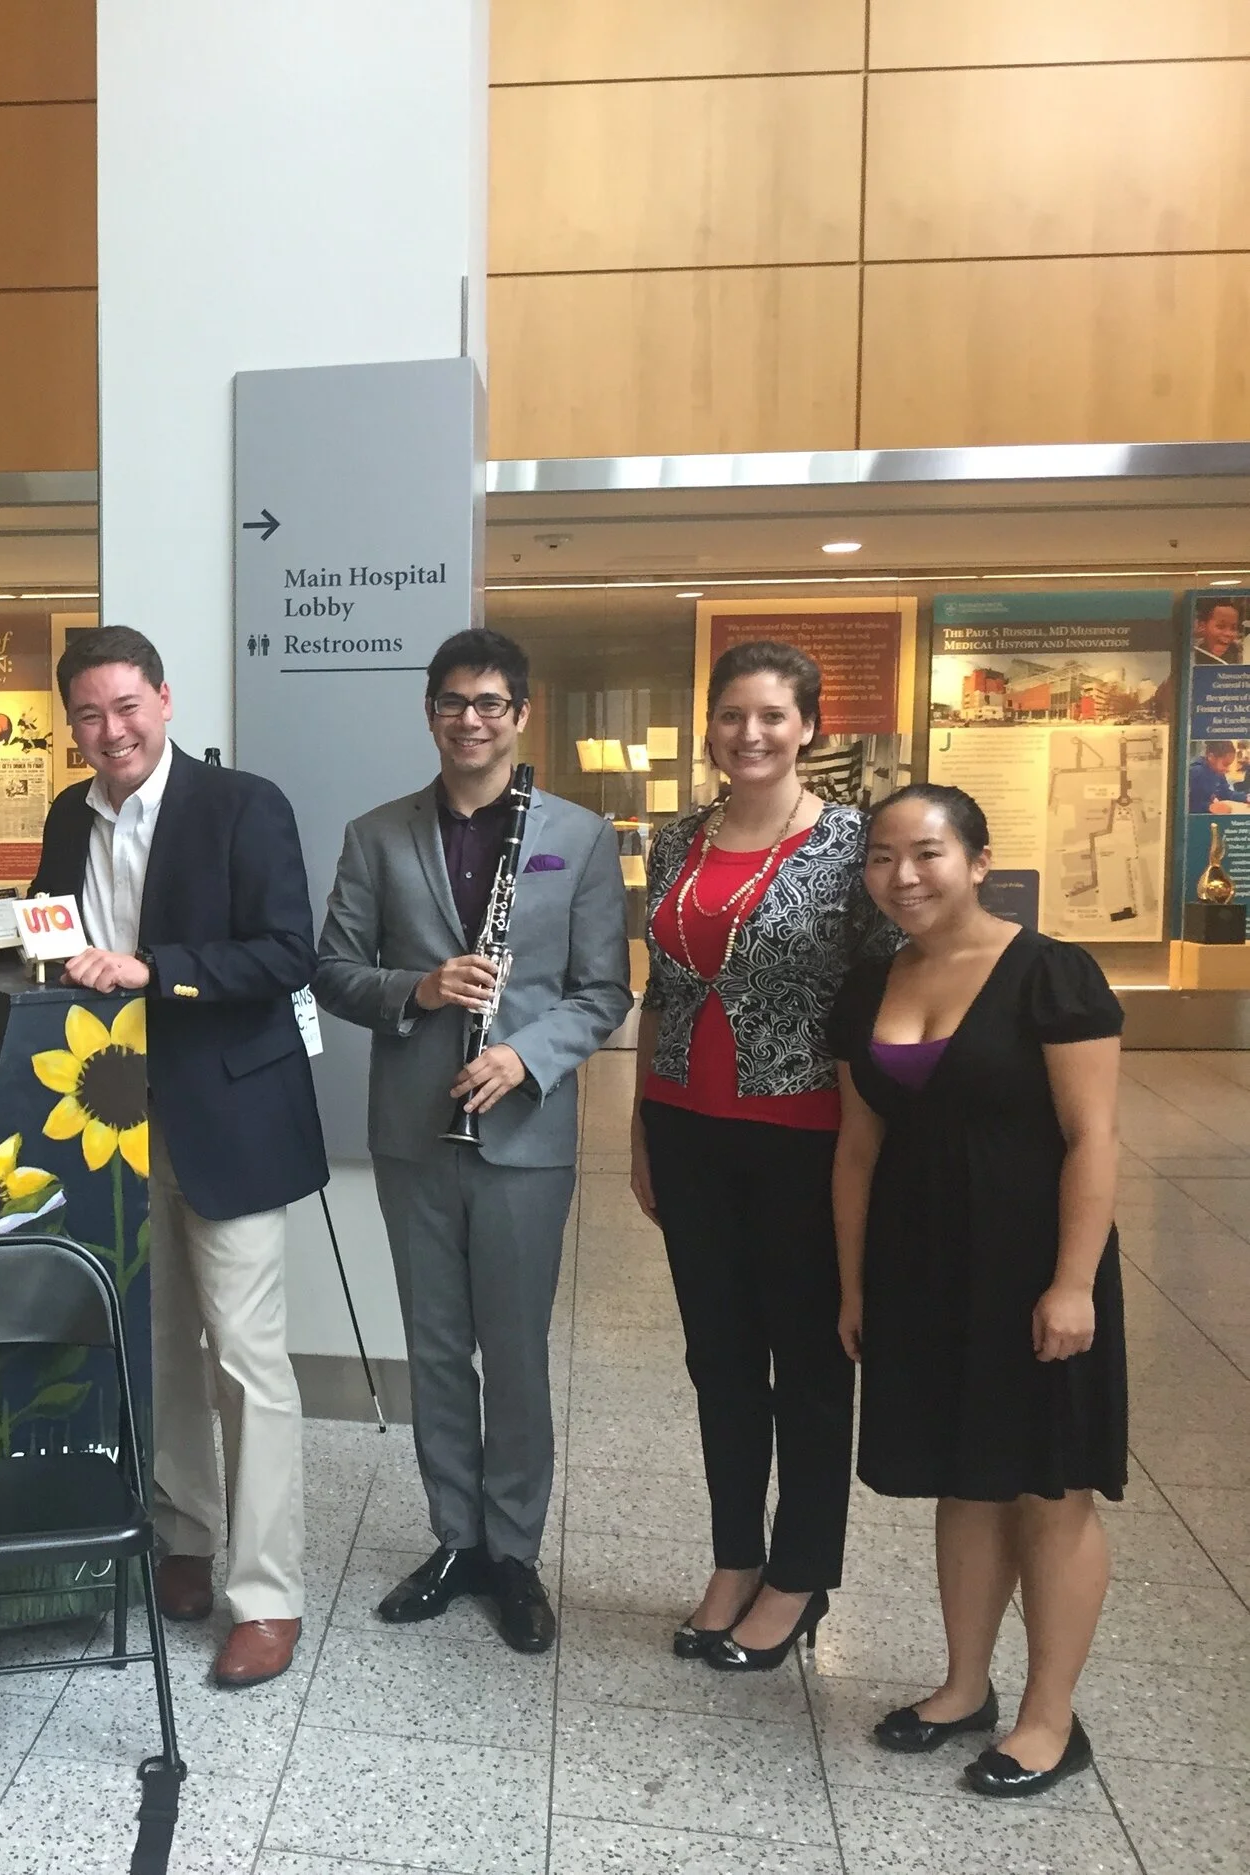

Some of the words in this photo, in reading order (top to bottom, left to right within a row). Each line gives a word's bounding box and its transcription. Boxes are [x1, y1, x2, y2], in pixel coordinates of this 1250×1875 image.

[284, 568, 342, 588] Main
[349, 563, 447, 591] Hospital
[284, 596, 355, 622] Lobby
[943, 628, 964, 638] THE
[966, 628, 990, 638] PAUL
[1050, 626, 1068, 636] MD
[1071, 626, 1115, 636] MUSEUM
[1117, 626, 1130, 635] OF
[284, 634, 403, 654] Restrooms
[944, 640, 994, 651] MEDICAL
[996, 640, 1040, 649] HISTORY
[1042, 640, 1064, 648] AND
[1066, 638, 1130, 648] INNOVATION
[293, 988, 313, 1007] ANS
